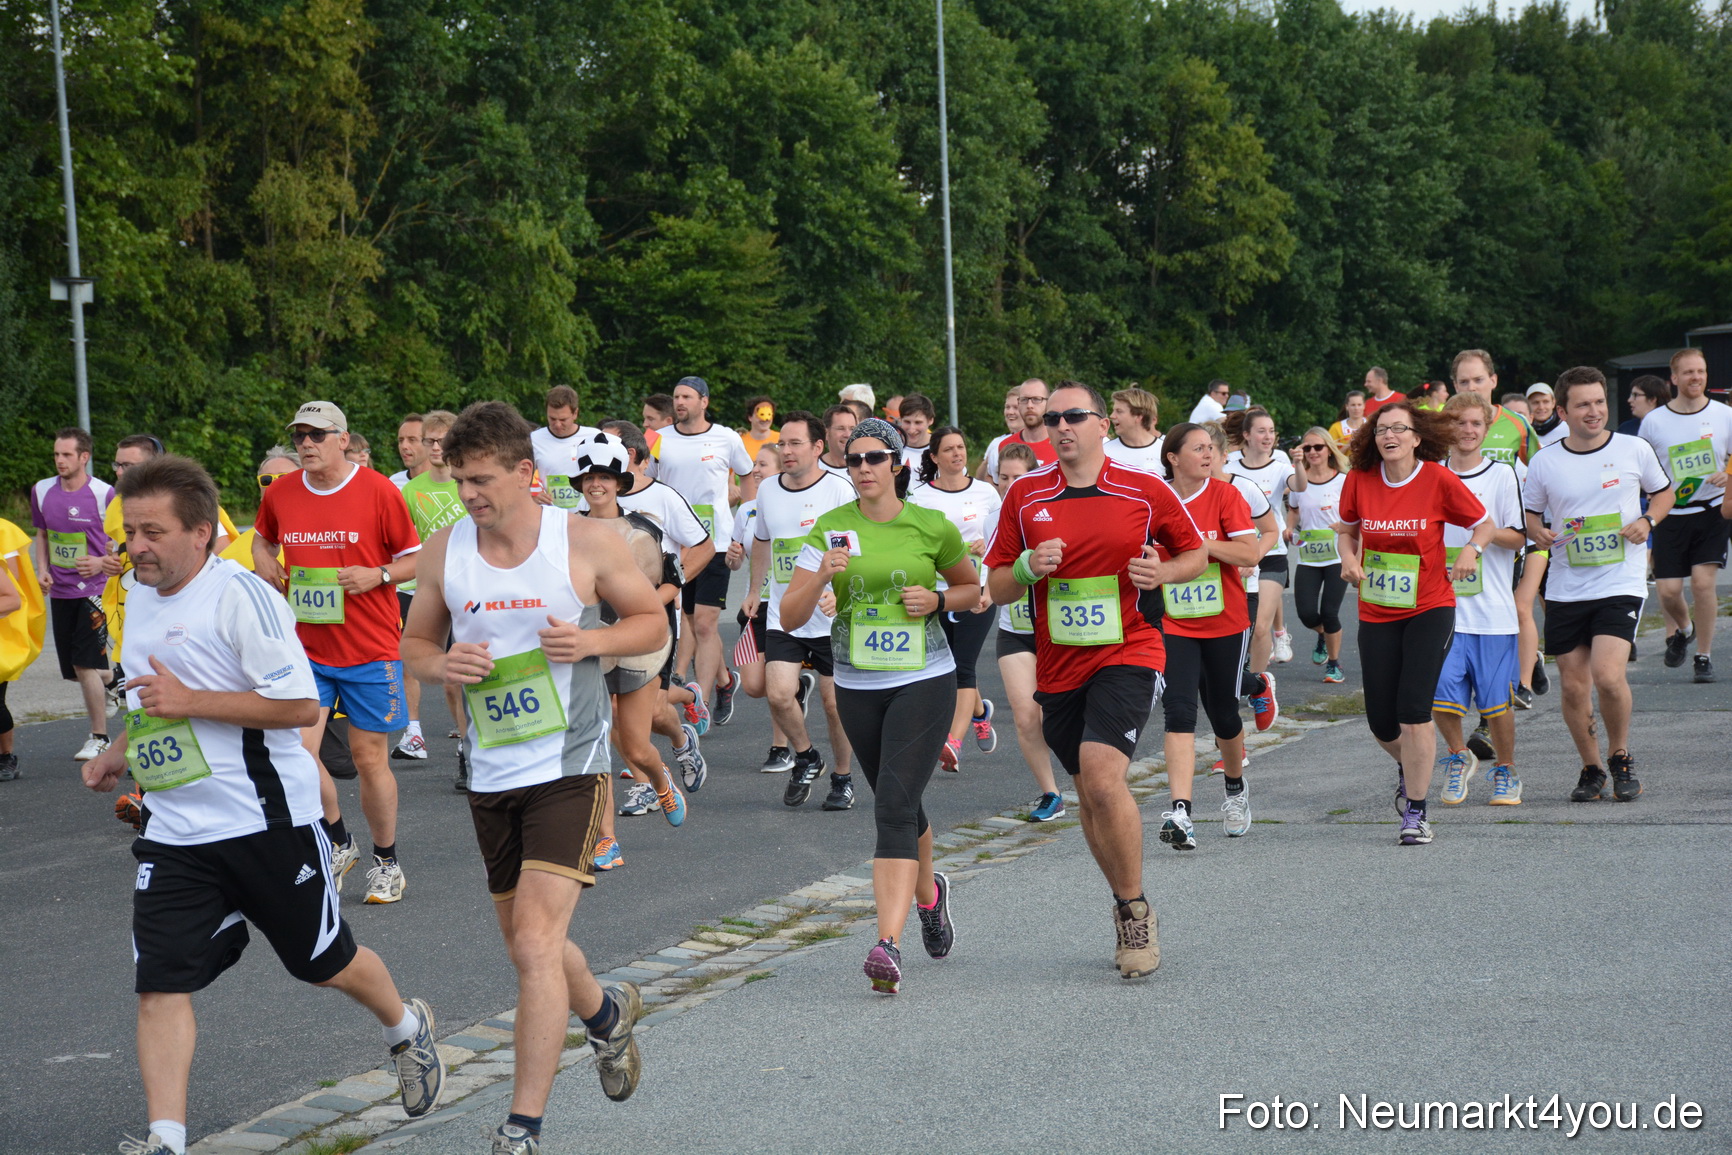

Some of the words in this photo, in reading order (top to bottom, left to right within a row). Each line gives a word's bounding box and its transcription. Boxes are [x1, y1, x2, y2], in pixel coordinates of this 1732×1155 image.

[1676, 452, 1711, 471] 1516
[551, 488, 581, 500] 1529
[283, 530, 346, 544] NEUMARKT
[1571, 533, 1619, 553] 1533
[54, 545, 78, 559] 467
[1302, 541, 1331, 554] 1521
[1367, 571, 1411, 593] 1413
[292, 588, 336, 608] 1401
[1169, 584, 1218, 604] 1412
[484, 598, 548, 612] KLEBL
[1013, 603, 1031, 619] 15
[1060, 603, 1106, 628] 335
[864, 630, 911, 653] 482
[484, 687, 541, 722] 546
[136, 735, 184, 770] 563
[294, 869, 317, 885] adidas
